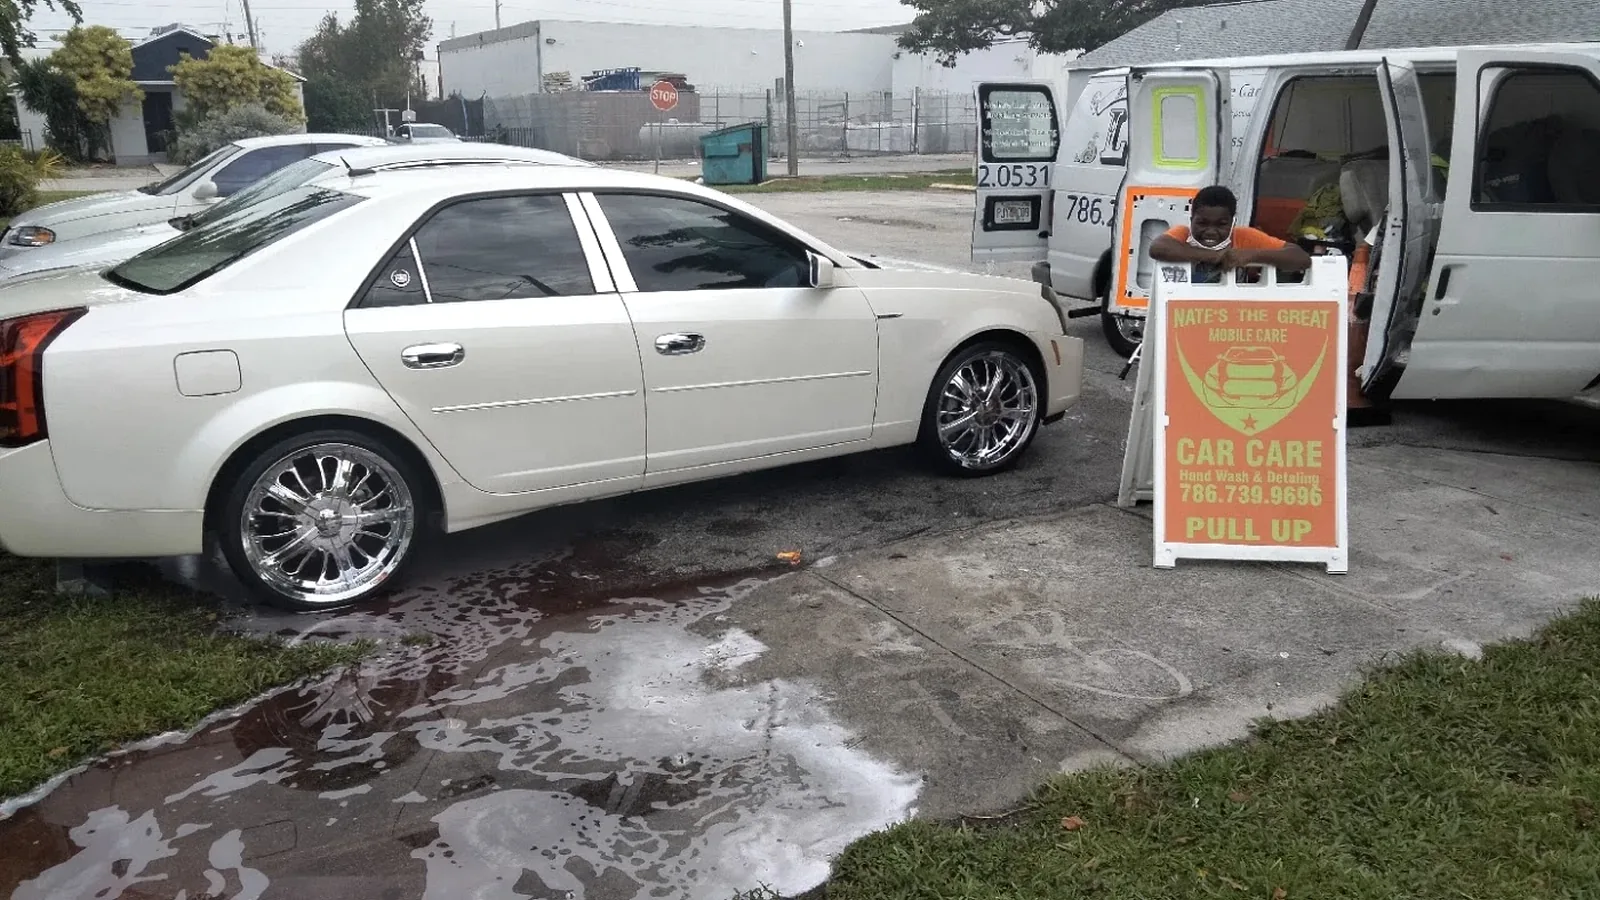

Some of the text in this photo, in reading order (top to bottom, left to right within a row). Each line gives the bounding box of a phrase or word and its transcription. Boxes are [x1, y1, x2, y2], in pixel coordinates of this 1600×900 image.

[652, 89, 676, 103] STOP
[978, 164, 1049, 187] 2.0531
[1173, 308, 1330, 329] NATE'S THE GREAT
[1208, 327, 1288, 343] MOBILE CARE
[1176, 437, 1322, 467] CAR CARE
[1179, 469, 1212, 482] Hand
[1215, 469, 1249, 483] Wash
[1253, 471, 1263, 483] &
[1179, 483, 1322, 506] 786.739.9696
[1186, 517, 1312, 542] PULL UP
